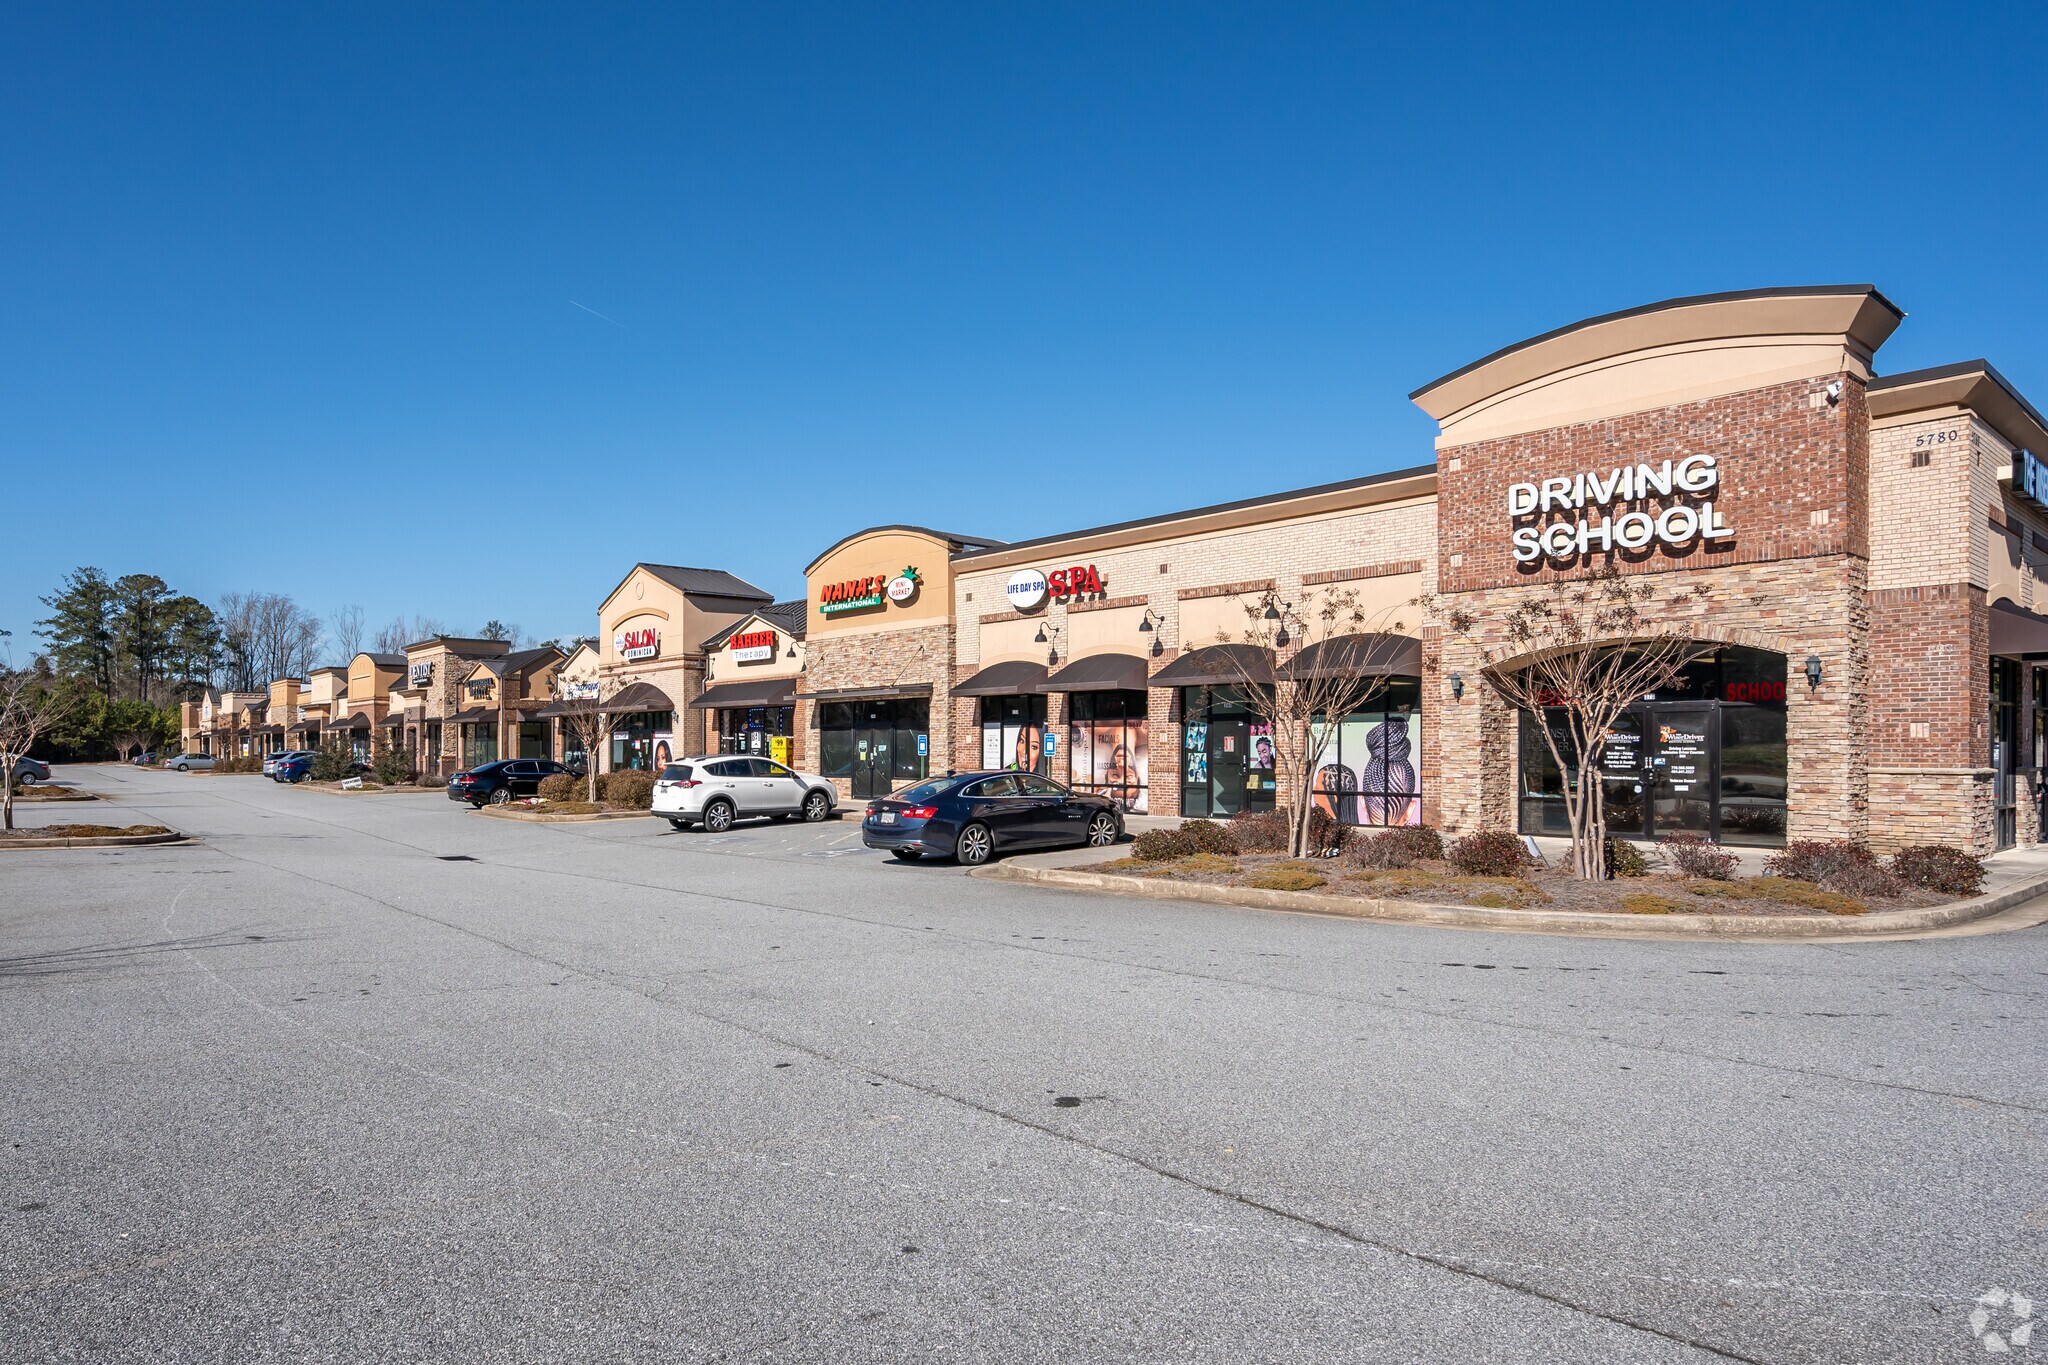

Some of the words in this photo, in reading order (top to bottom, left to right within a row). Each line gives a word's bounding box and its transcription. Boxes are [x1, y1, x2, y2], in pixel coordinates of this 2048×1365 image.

[1916, 430, 1958, 447] 5780
[1508, 454, 1717, 517] DRIVING
[1512, 501, 1735, 562] SCHOOL
[820, 574, 884, 603] NANA'S
[1007, 583, 1019, 595] LIFE
[1020, 582, 1032, 593] DAY
[1032, 581, 1045, 592] SPA
[1048, 564, 1102, 598] SPA
[891, 588, 910, 597] MARKET
[823, 598, 877, 613] INTERNATIONAL
[625, 628, 656, 650] SALON
[730, 630, 774, 650] BARBER
[627, 648, 652, 658] DOMINICAN
[734, 650, 769, 659] Therapy
[411, 662, 431, 678] DENTIST
[1098, 734, 1121, 744] FACIALS
